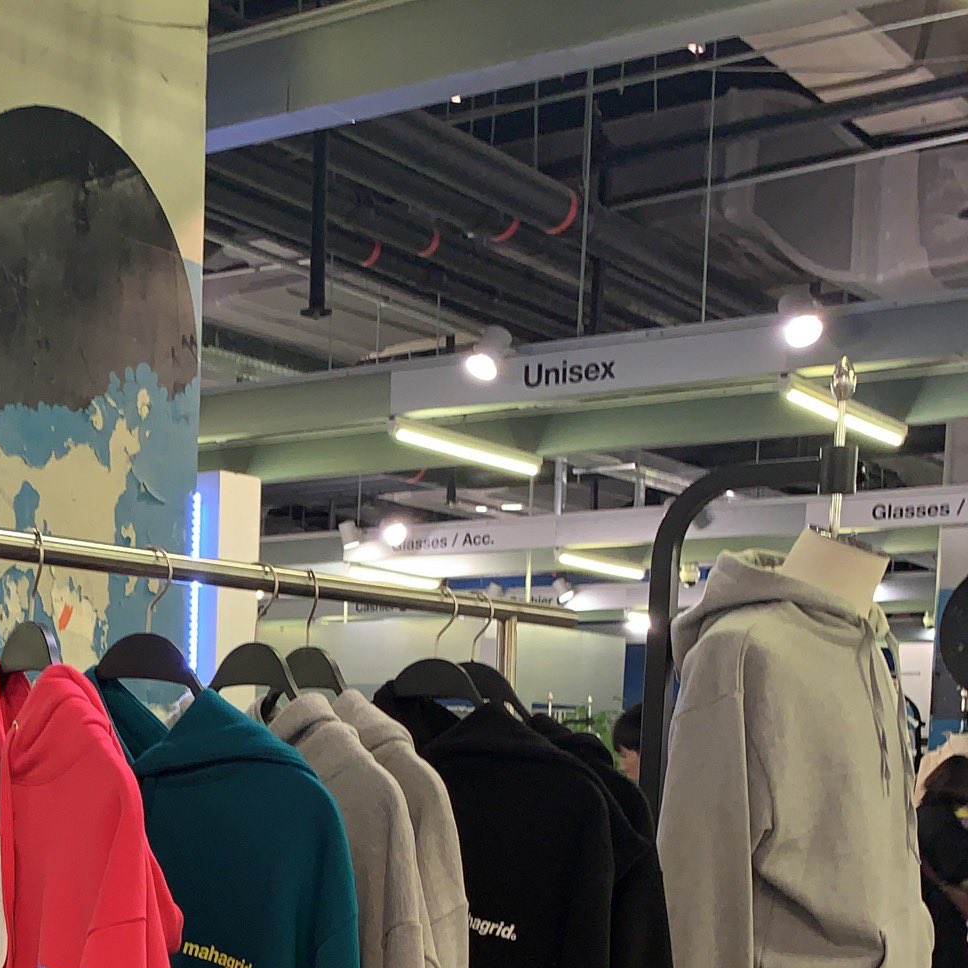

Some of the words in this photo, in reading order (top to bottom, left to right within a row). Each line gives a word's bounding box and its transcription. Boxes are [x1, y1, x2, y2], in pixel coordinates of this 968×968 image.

[524, 360, 615, 389] Unisex
[872, 503, 950, 520] Glasses
[462, 532, 494, 547] Acc.
